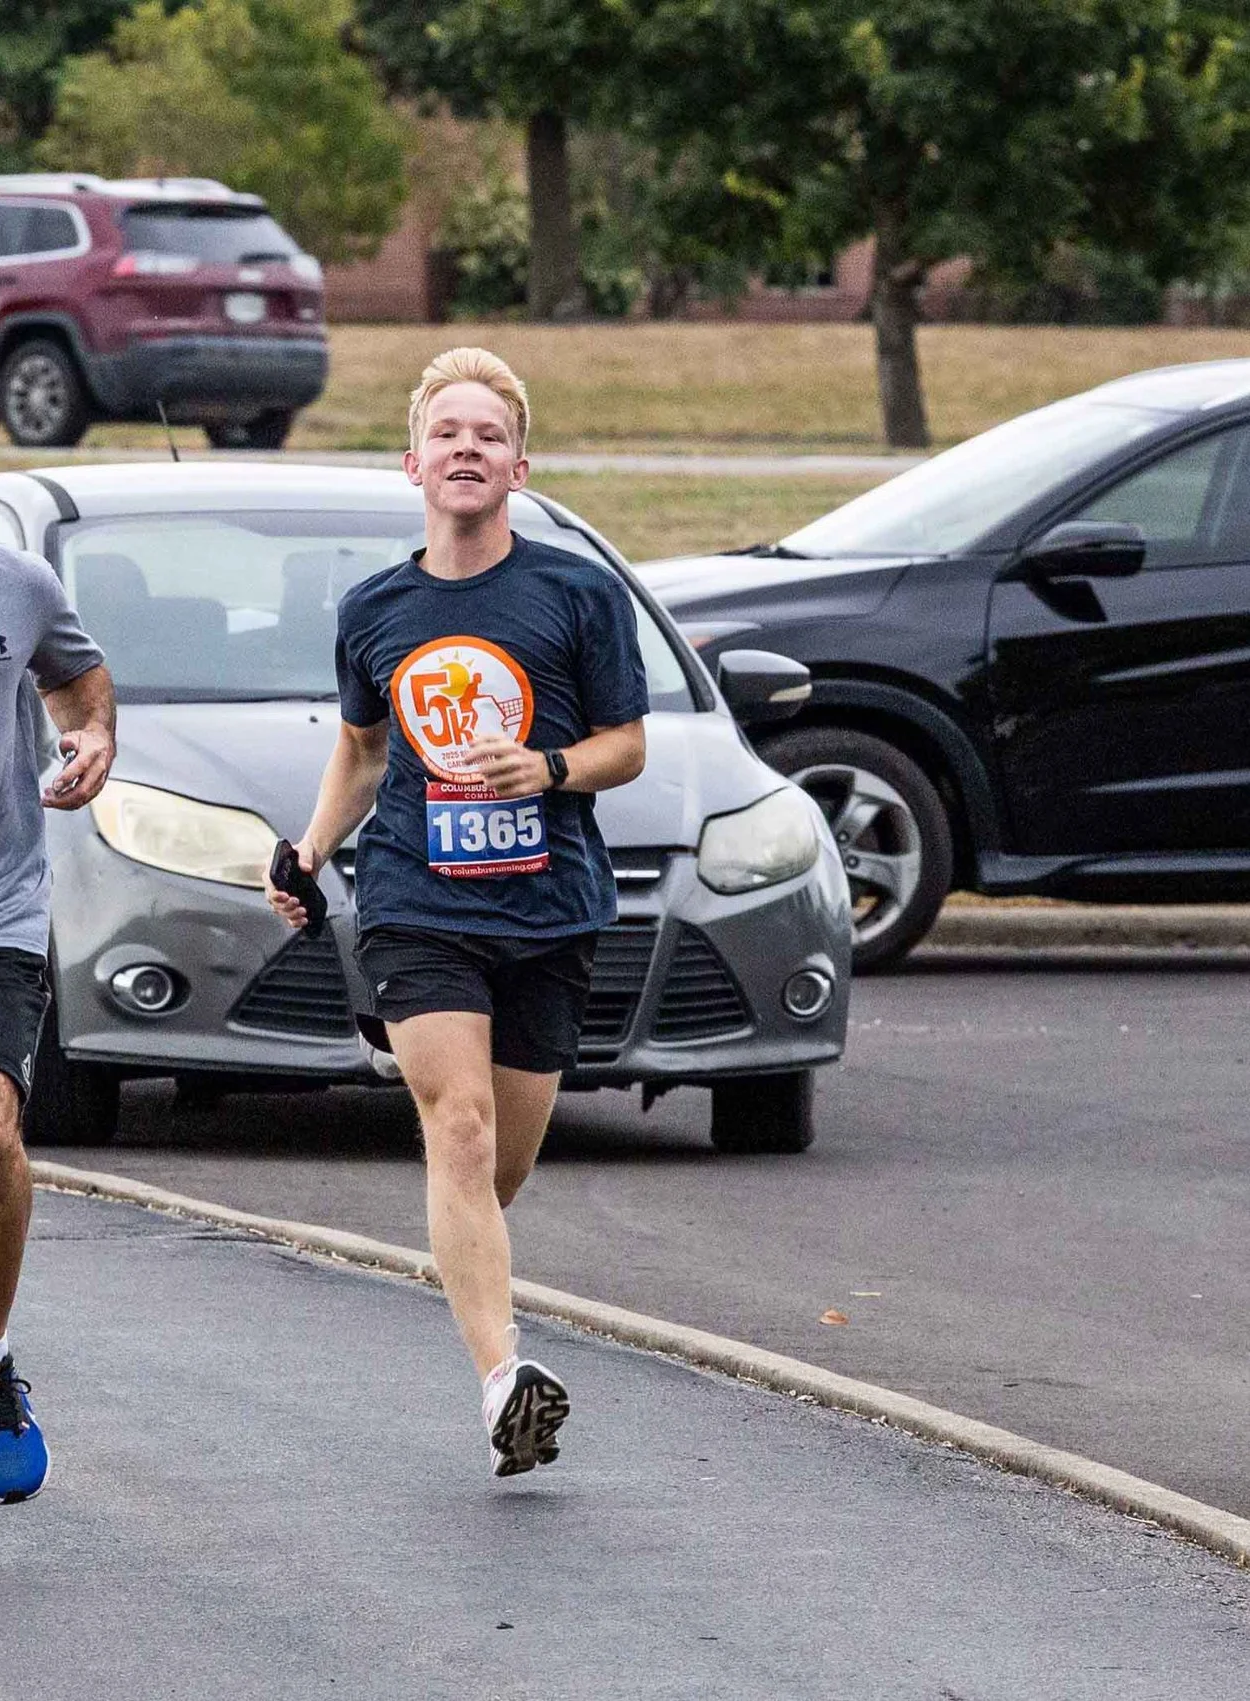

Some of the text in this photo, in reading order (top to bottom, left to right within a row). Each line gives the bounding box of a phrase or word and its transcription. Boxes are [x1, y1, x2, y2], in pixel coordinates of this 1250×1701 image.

[440, 784, 487, 792] COLUMBUS
[433, 805, 542, 852] 1365
[452, 862, 543, 876] columbusrunning.com
